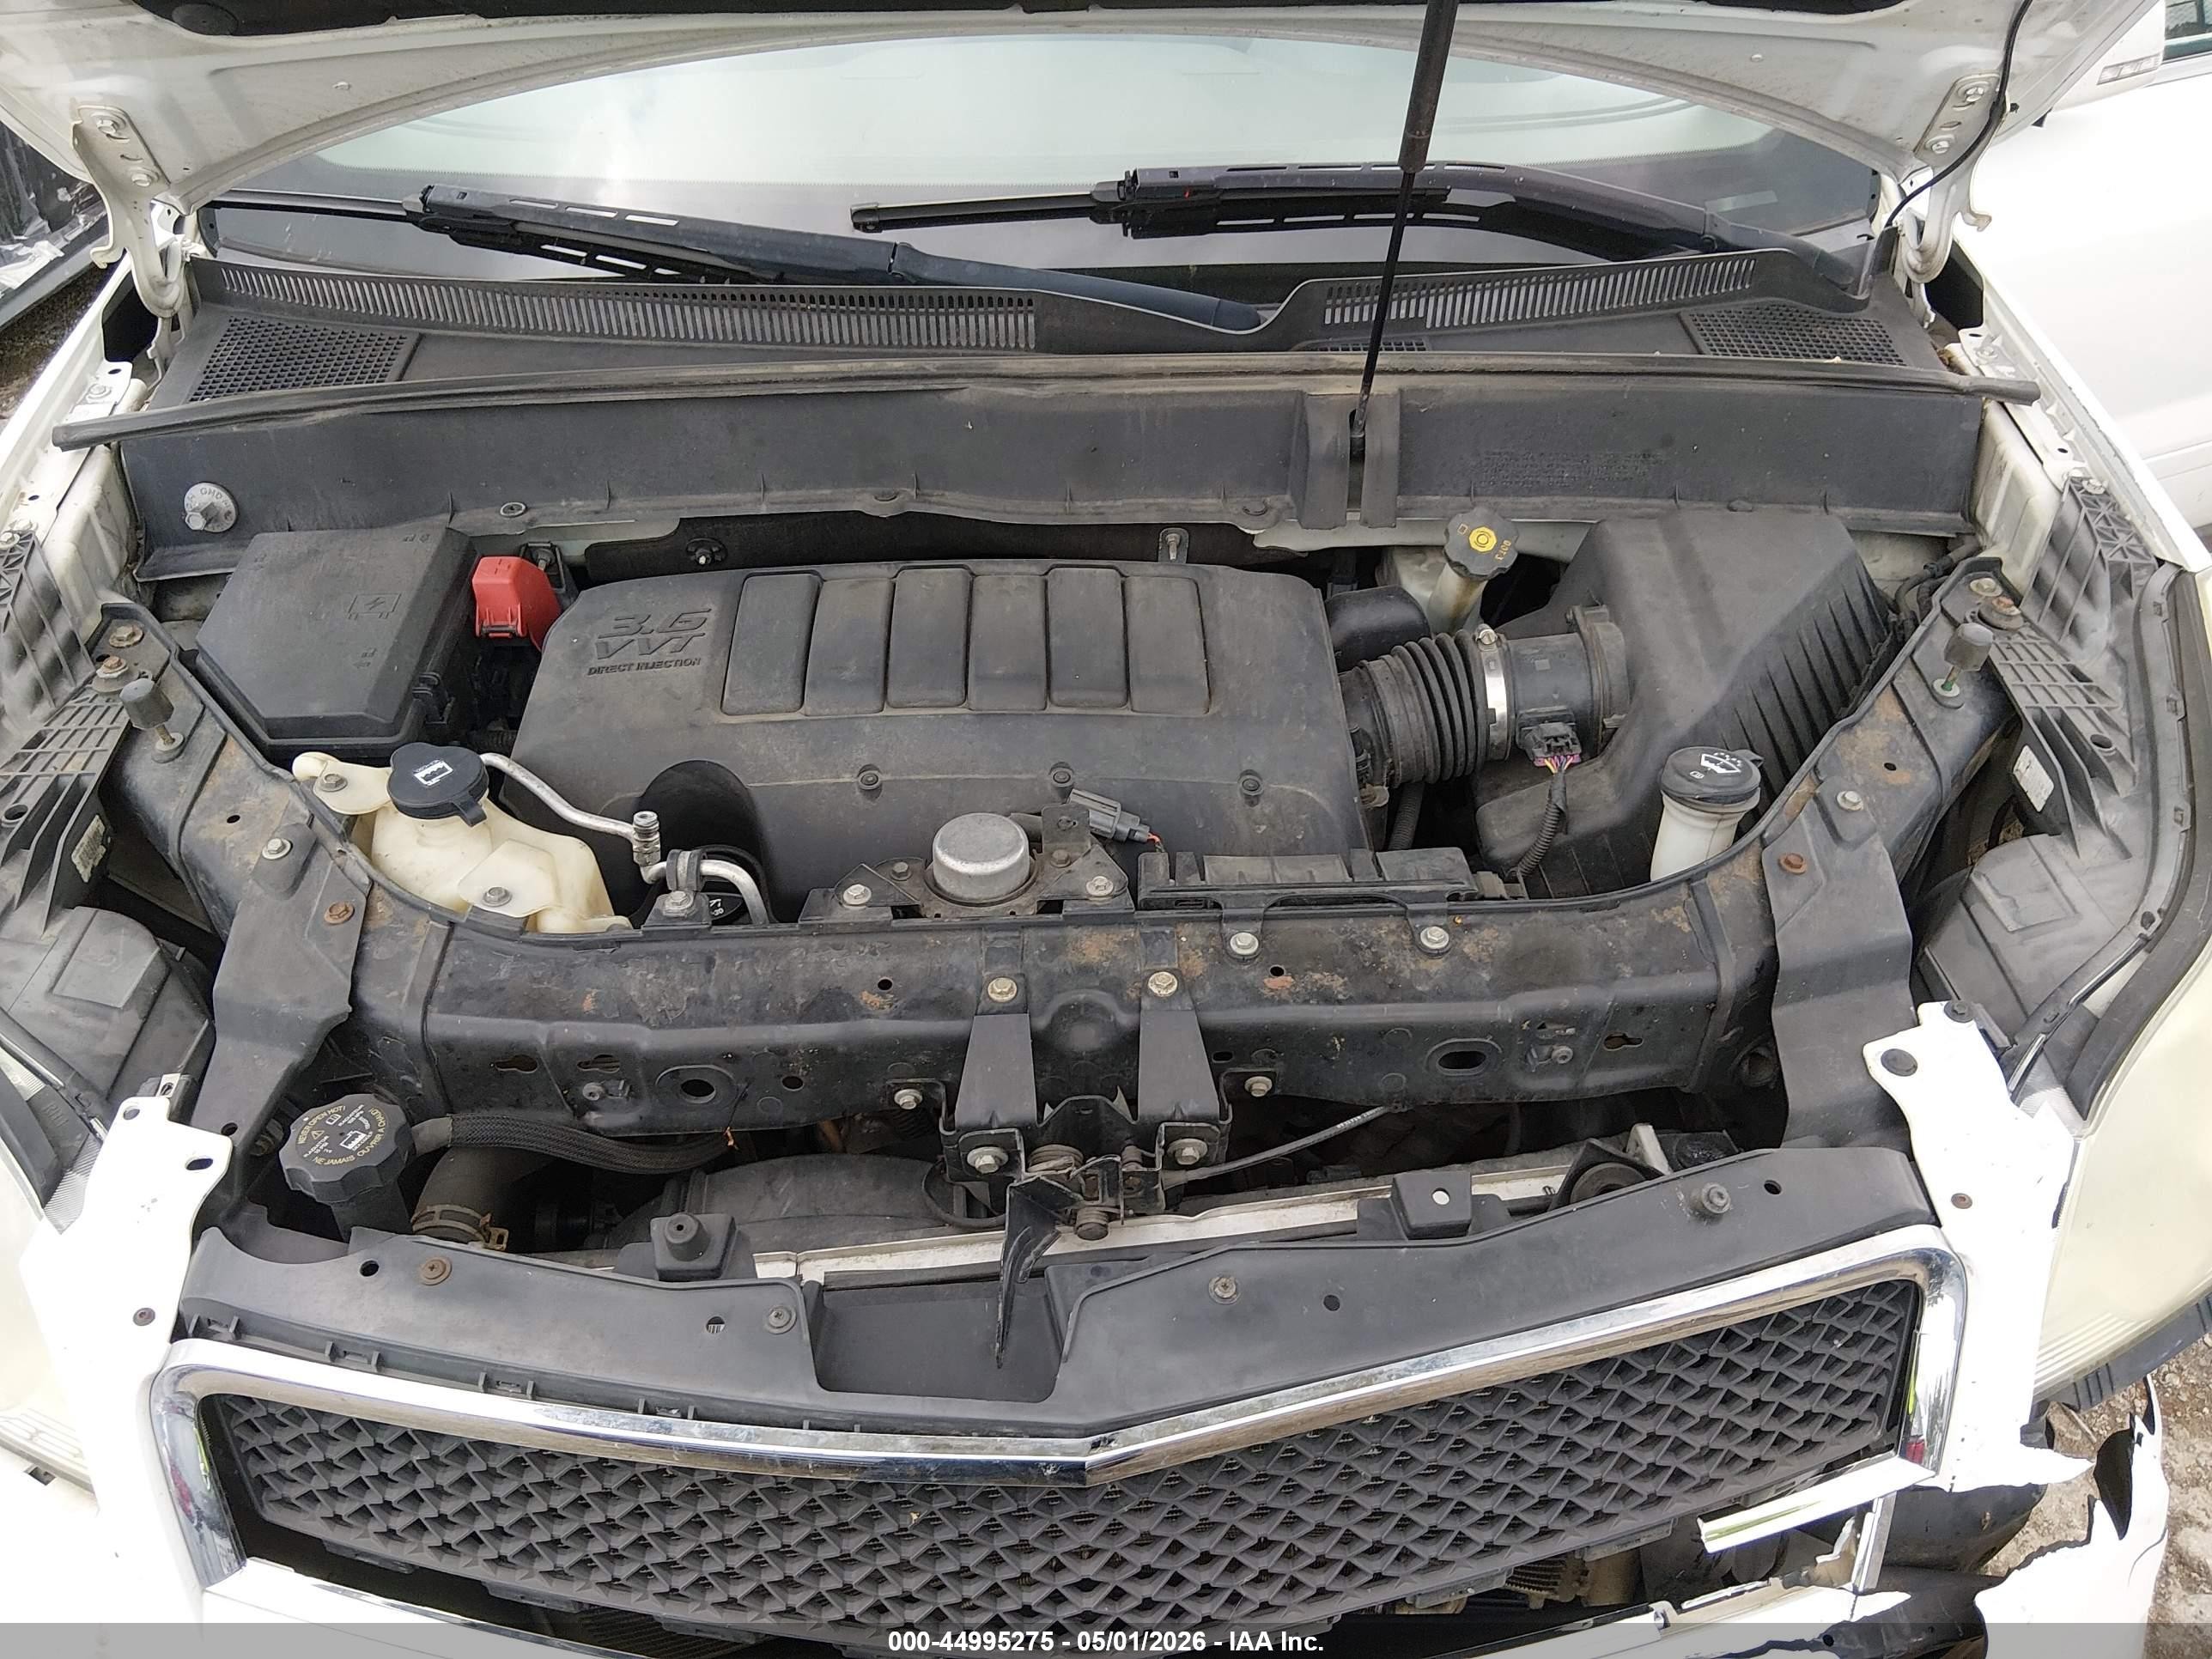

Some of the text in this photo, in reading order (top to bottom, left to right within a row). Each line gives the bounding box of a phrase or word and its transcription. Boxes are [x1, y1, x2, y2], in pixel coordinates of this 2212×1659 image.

[598, 608, 712, 639] 3.6
[594, 632, 706, 660] VVT
[586, 657, 702, 676] DIRECT INJECTION
[308, 1111, 328, 1126] OPEN
[313, 1155, 326, 1165] NE
[324, 1155, 356, 1165] JAMAIS
[356, 1133, 384, 1156] OUVRIR
